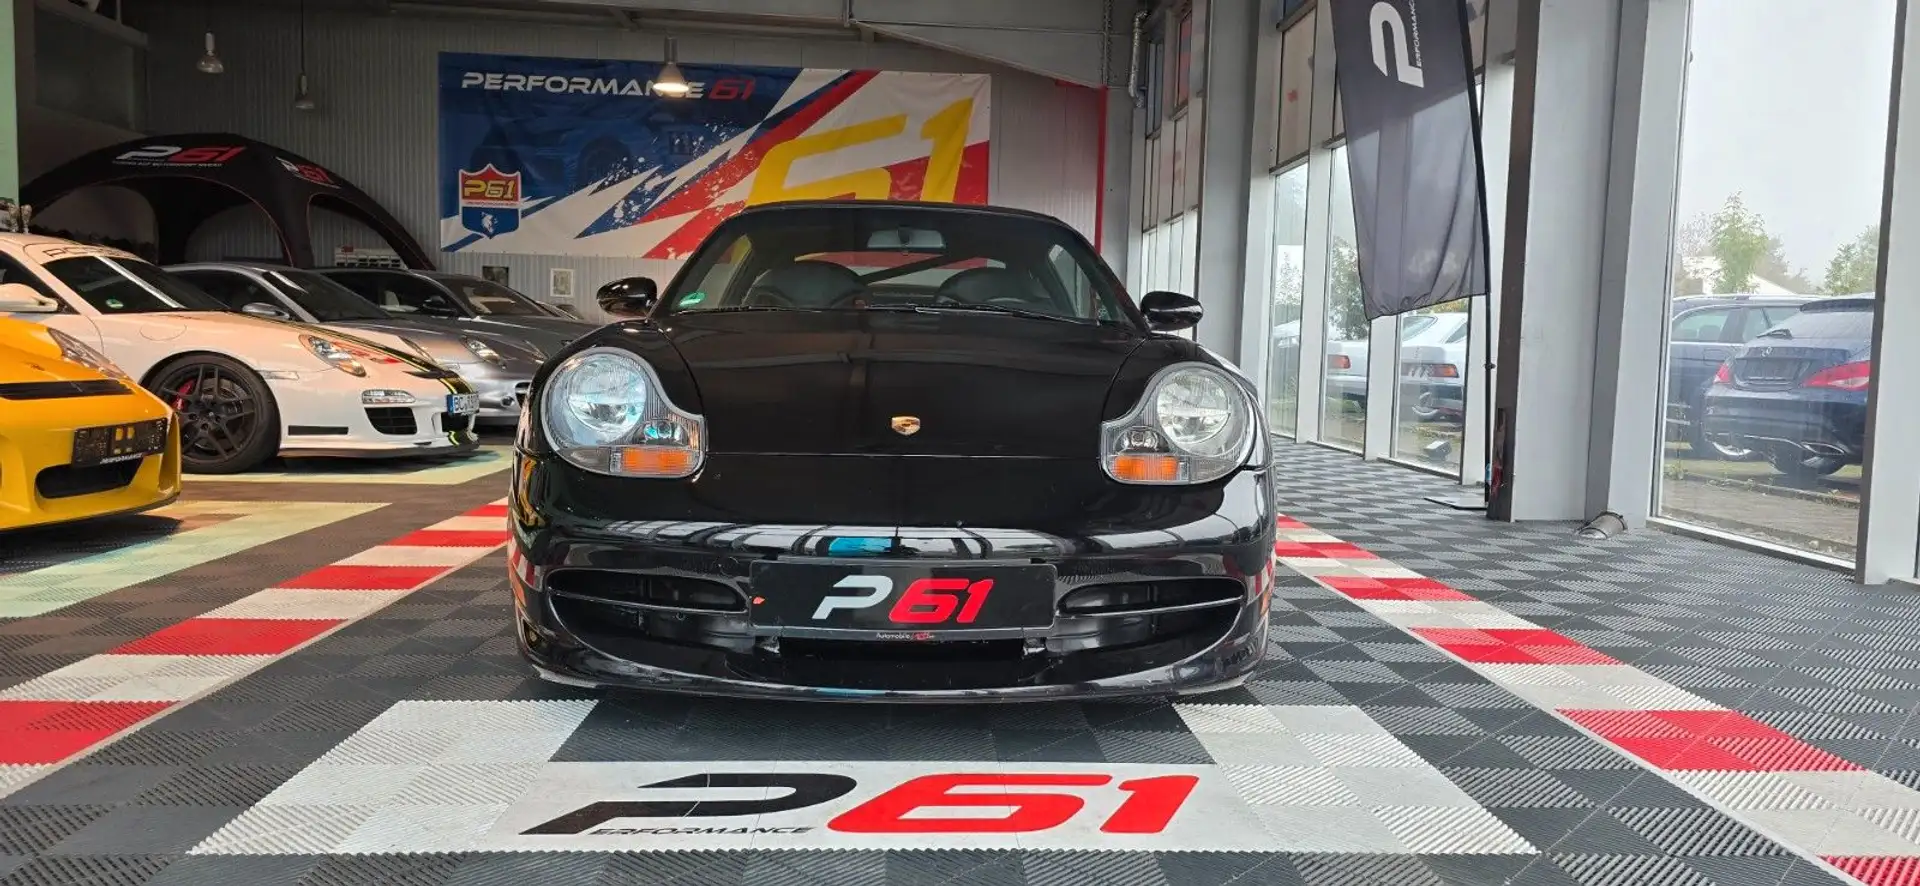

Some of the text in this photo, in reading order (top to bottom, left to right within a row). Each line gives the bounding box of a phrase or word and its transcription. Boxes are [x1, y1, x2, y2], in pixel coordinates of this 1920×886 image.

[461, 71, 756, 100] PERFORMANE 61
[464, 180, 516, 199] P61
[811, 574, 994, 624] P61
